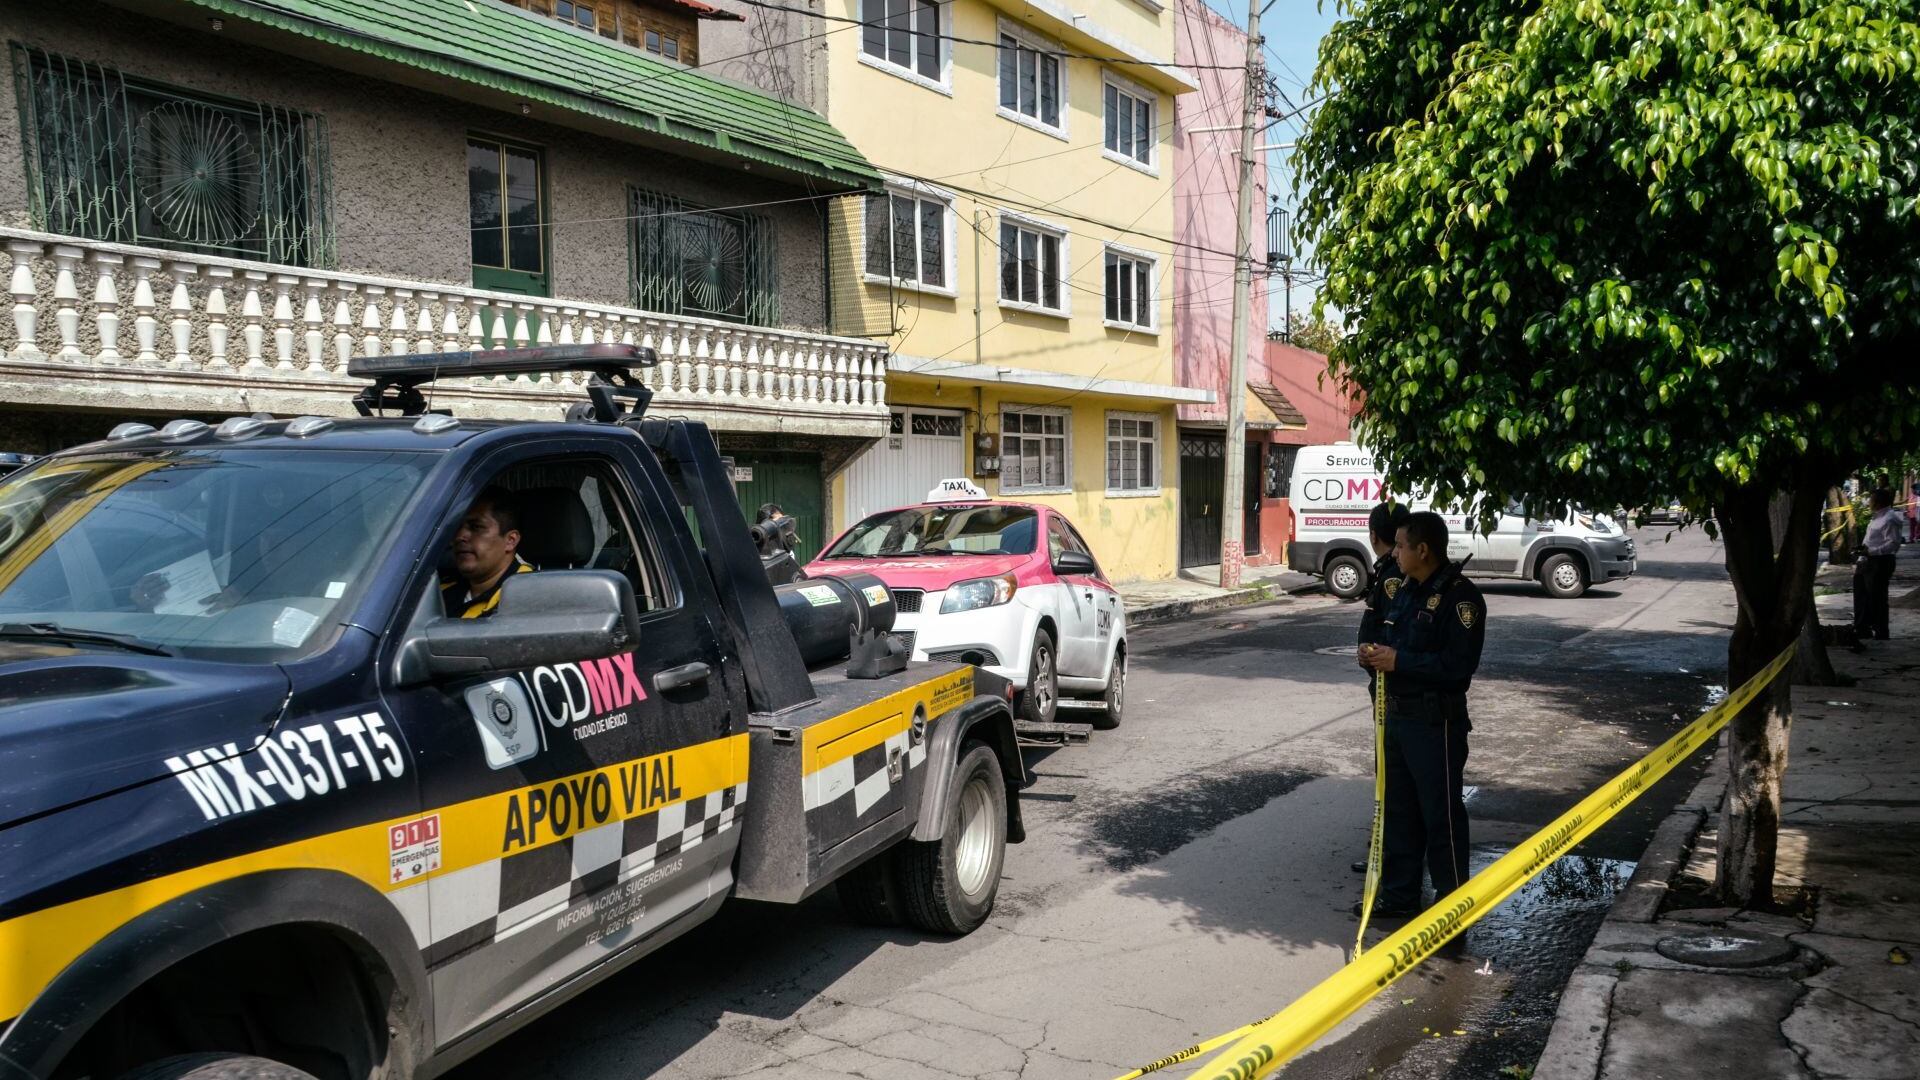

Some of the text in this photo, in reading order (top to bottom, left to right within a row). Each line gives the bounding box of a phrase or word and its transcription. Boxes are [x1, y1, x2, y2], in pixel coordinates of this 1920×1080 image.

[943, 481, 966, 490] TAXI
[1304, 479, 1391, 501] CDMX
[533, 652, 648, 728] CDMX
[573, 712, 628, 741] CIUDAD DE MÉXICO
[505, 744, 521, 757] SSP
[164, 712, 404, 820] MX-037-T5
[502, 755, 681, 852] APOYO VIAL
[394, 820, 434, 847] 911
[392, 846, 439, 867] EMERGENCIAS
[625, 858, 683, 897] SUGERENCIAS
[607, 894, 642, 921] QUEJAS
